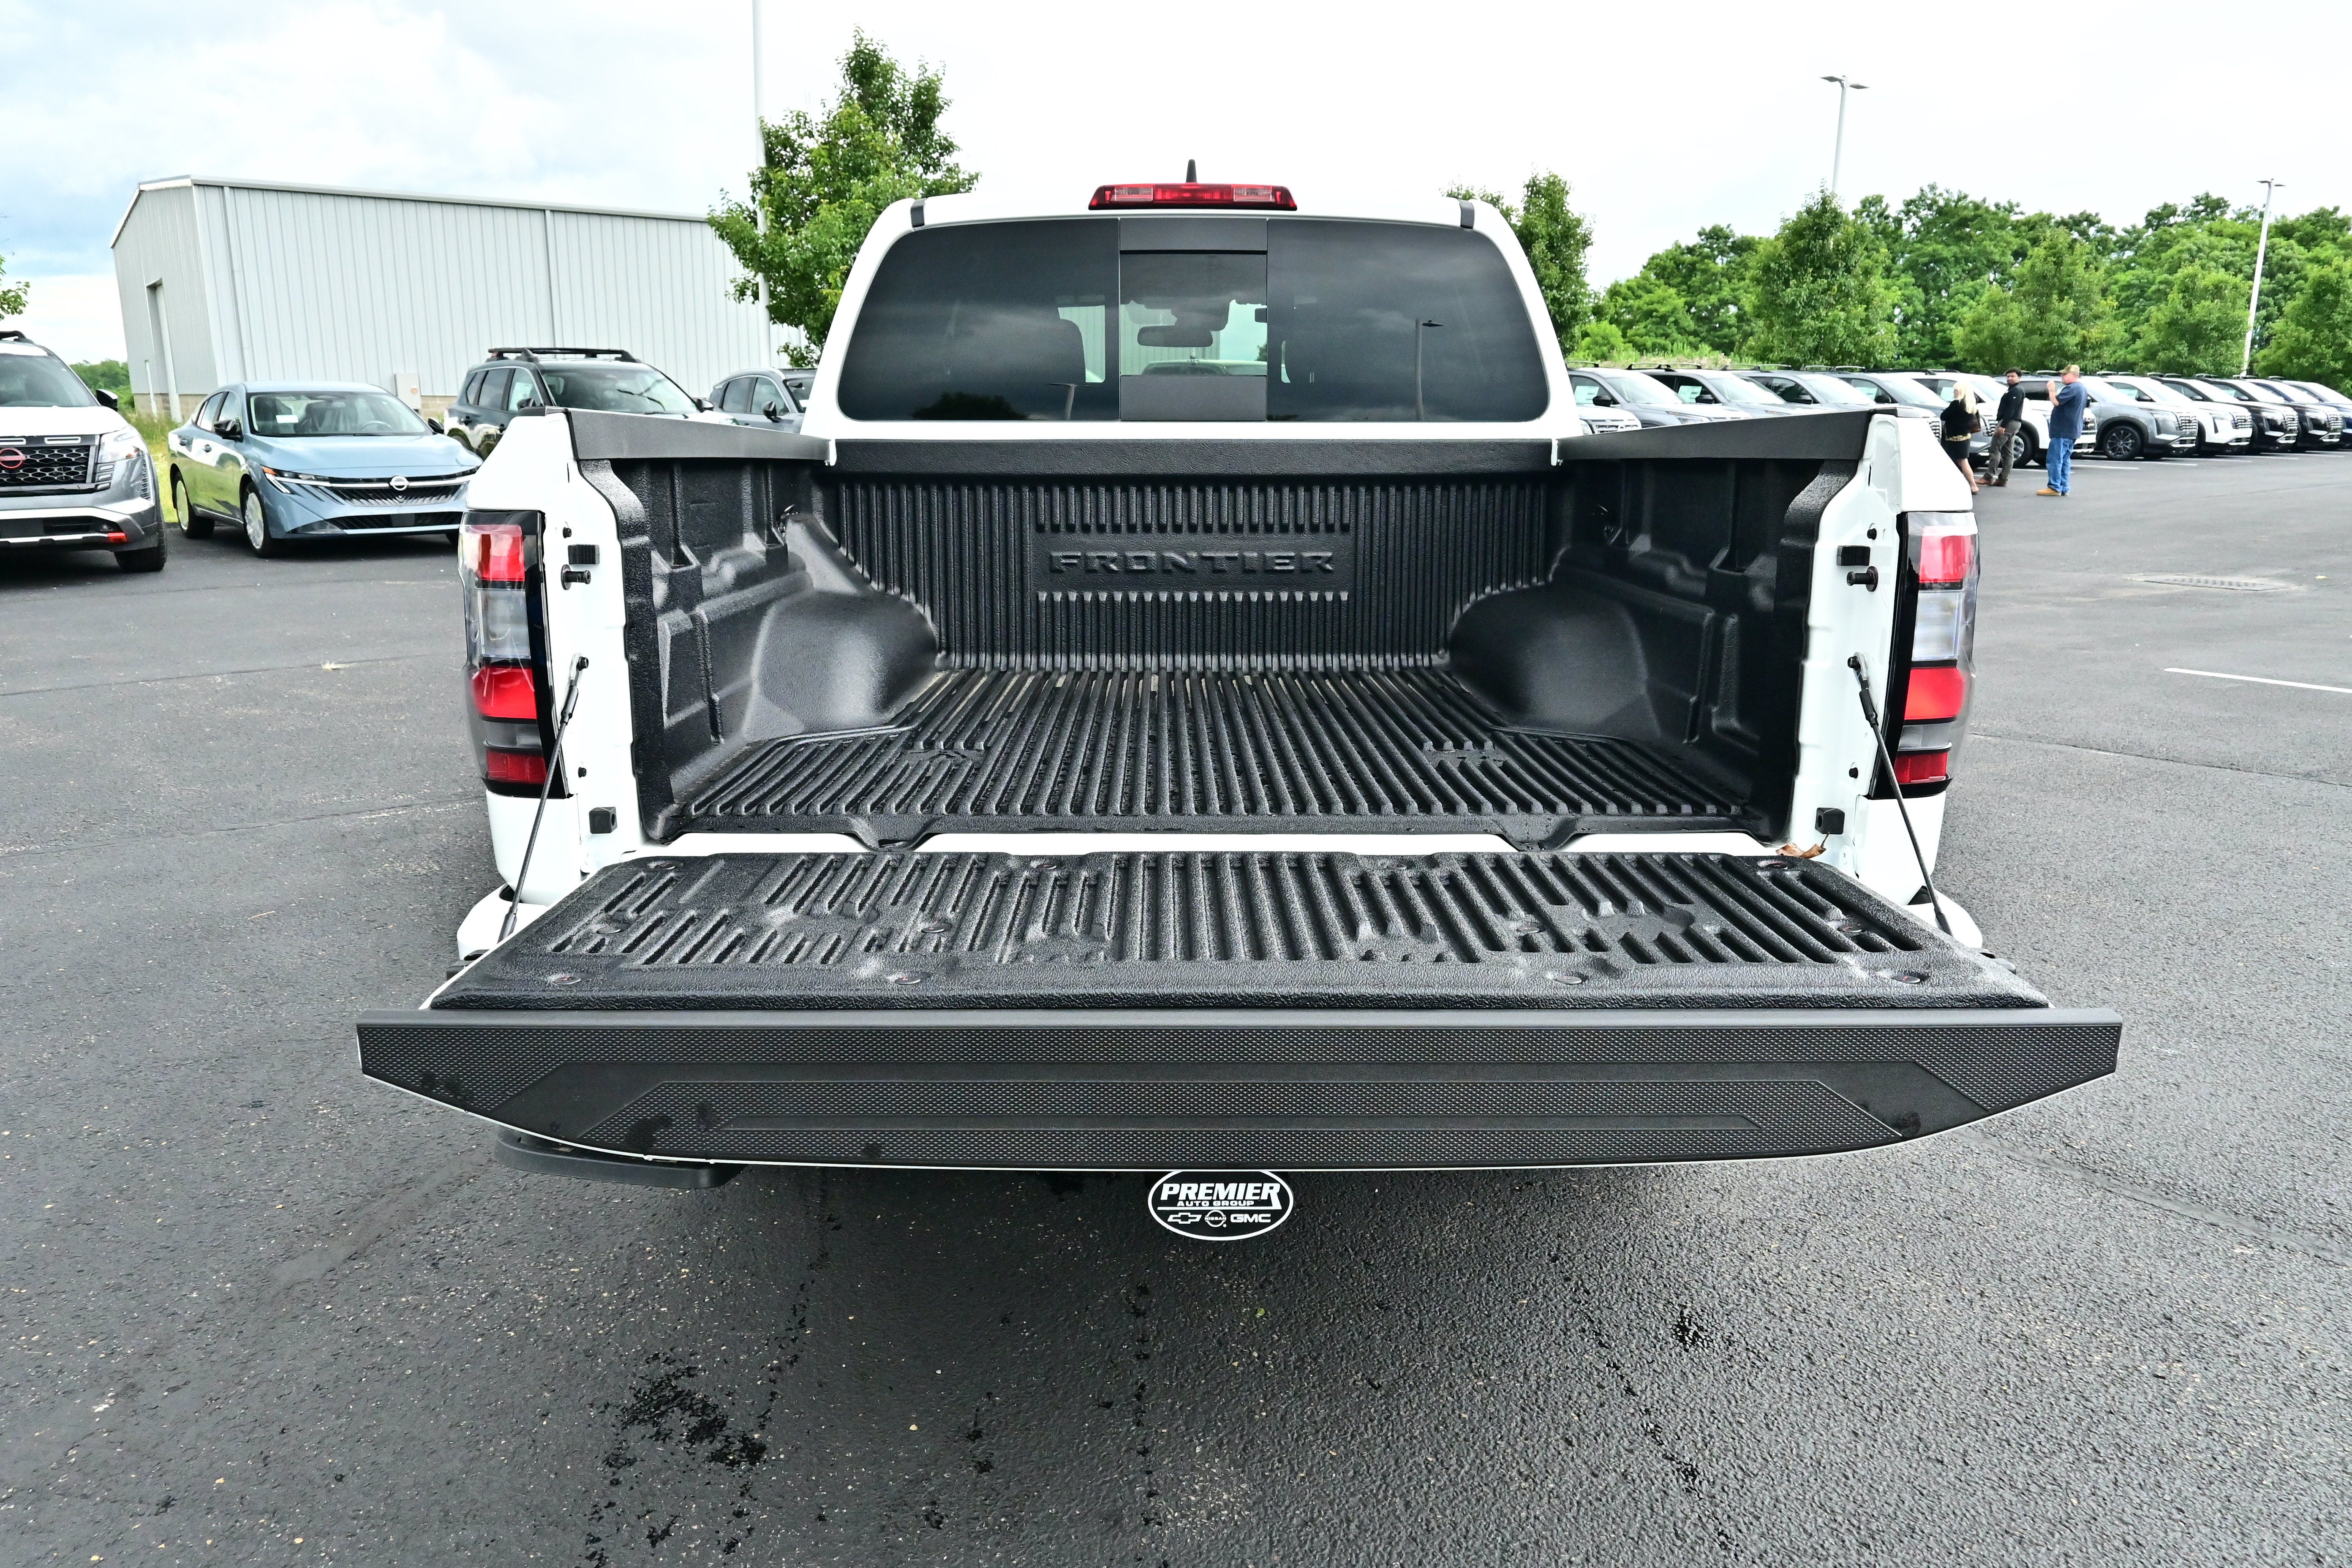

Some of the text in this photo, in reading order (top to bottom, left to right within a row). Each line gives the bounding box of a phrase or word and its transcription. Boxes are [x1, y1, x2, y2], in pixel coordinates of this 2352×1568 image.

[1050, 551, 1334, 573] FRONTIER
[1160, 1183, 1282, 1209] PREMIER
[1230, 1214, 1271, 1223] GMC
